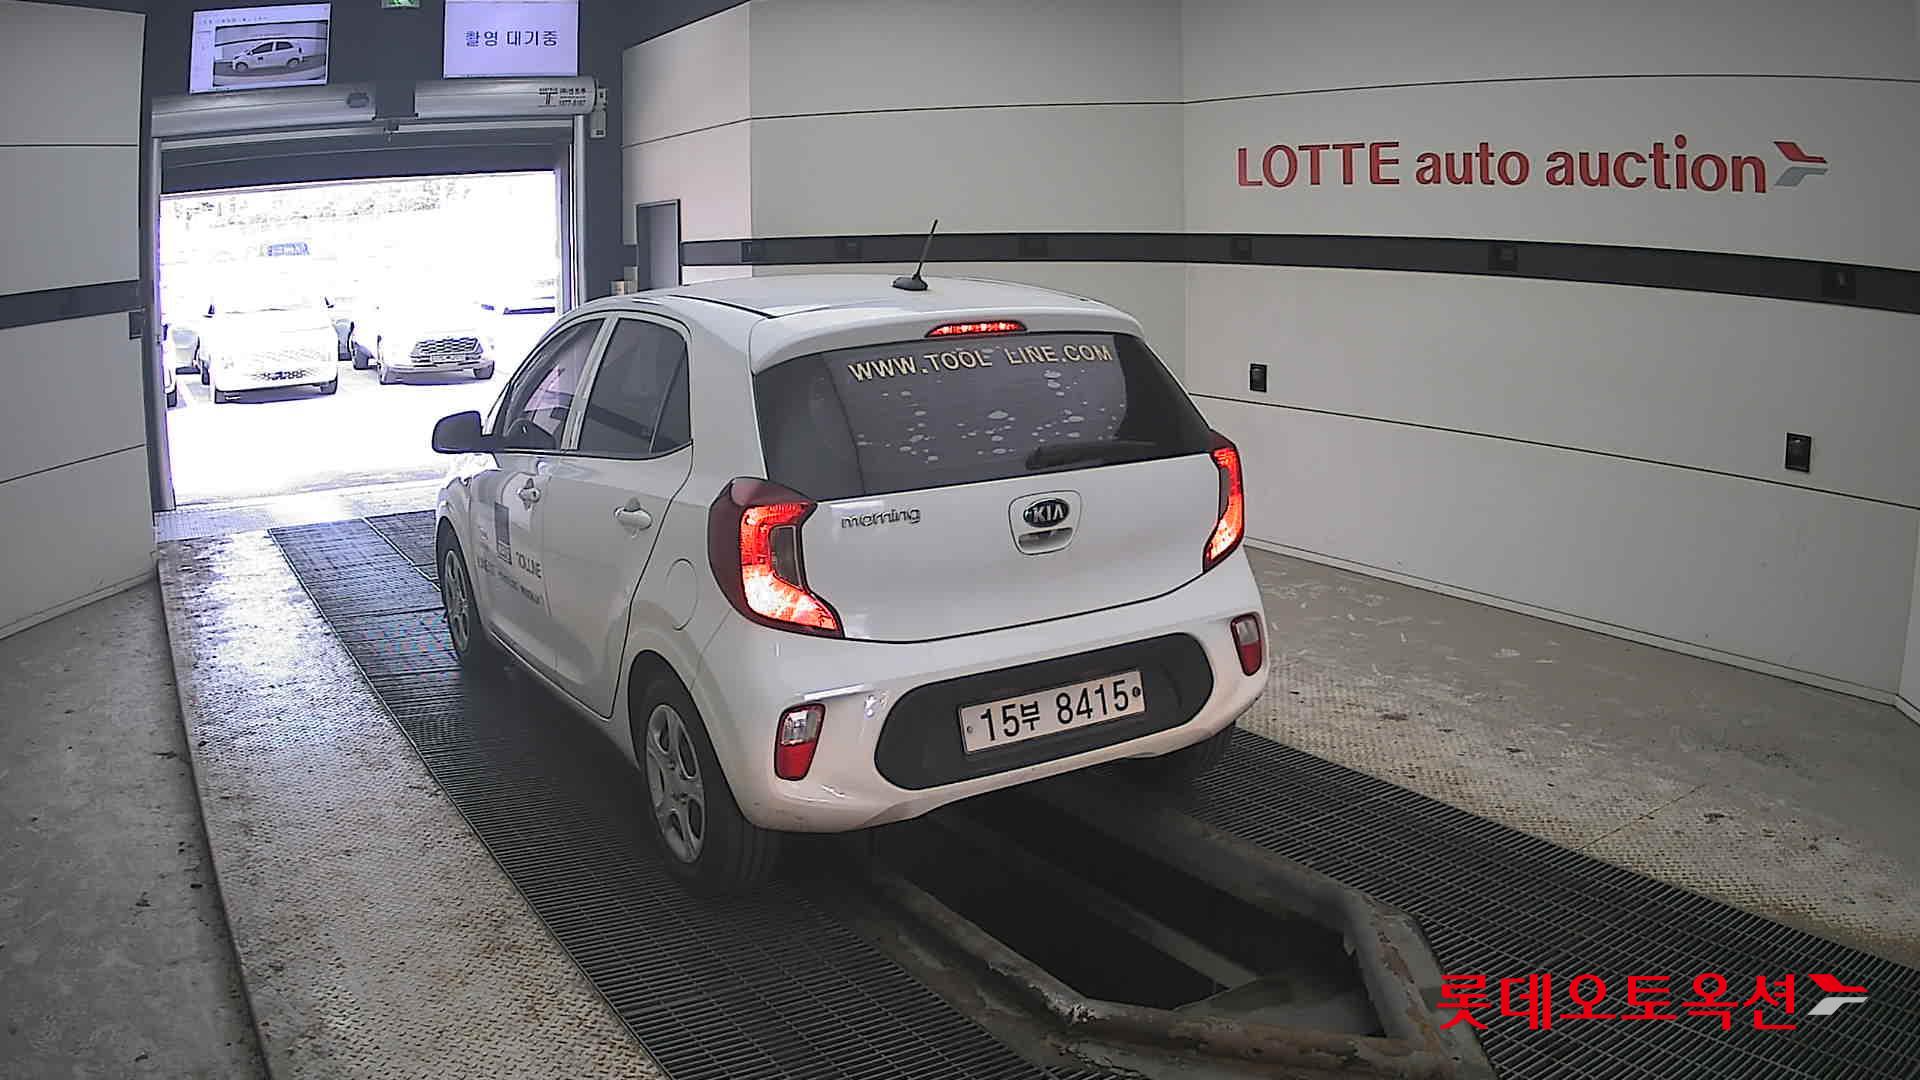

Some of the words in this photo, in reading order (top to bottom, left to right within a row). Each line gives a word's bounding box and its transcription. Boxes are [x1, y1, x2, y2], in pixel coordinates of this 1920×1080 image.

[507, 30, 557, 47] 대기중
[1237, 141, 1400, 188] LOTTE
[1415, 141, 1530, 187] auto
[1545, 134, 1767, 194] auction
[980, 700, 1041, 742] 15부
[1055, 679, 1129, 725] 8415
